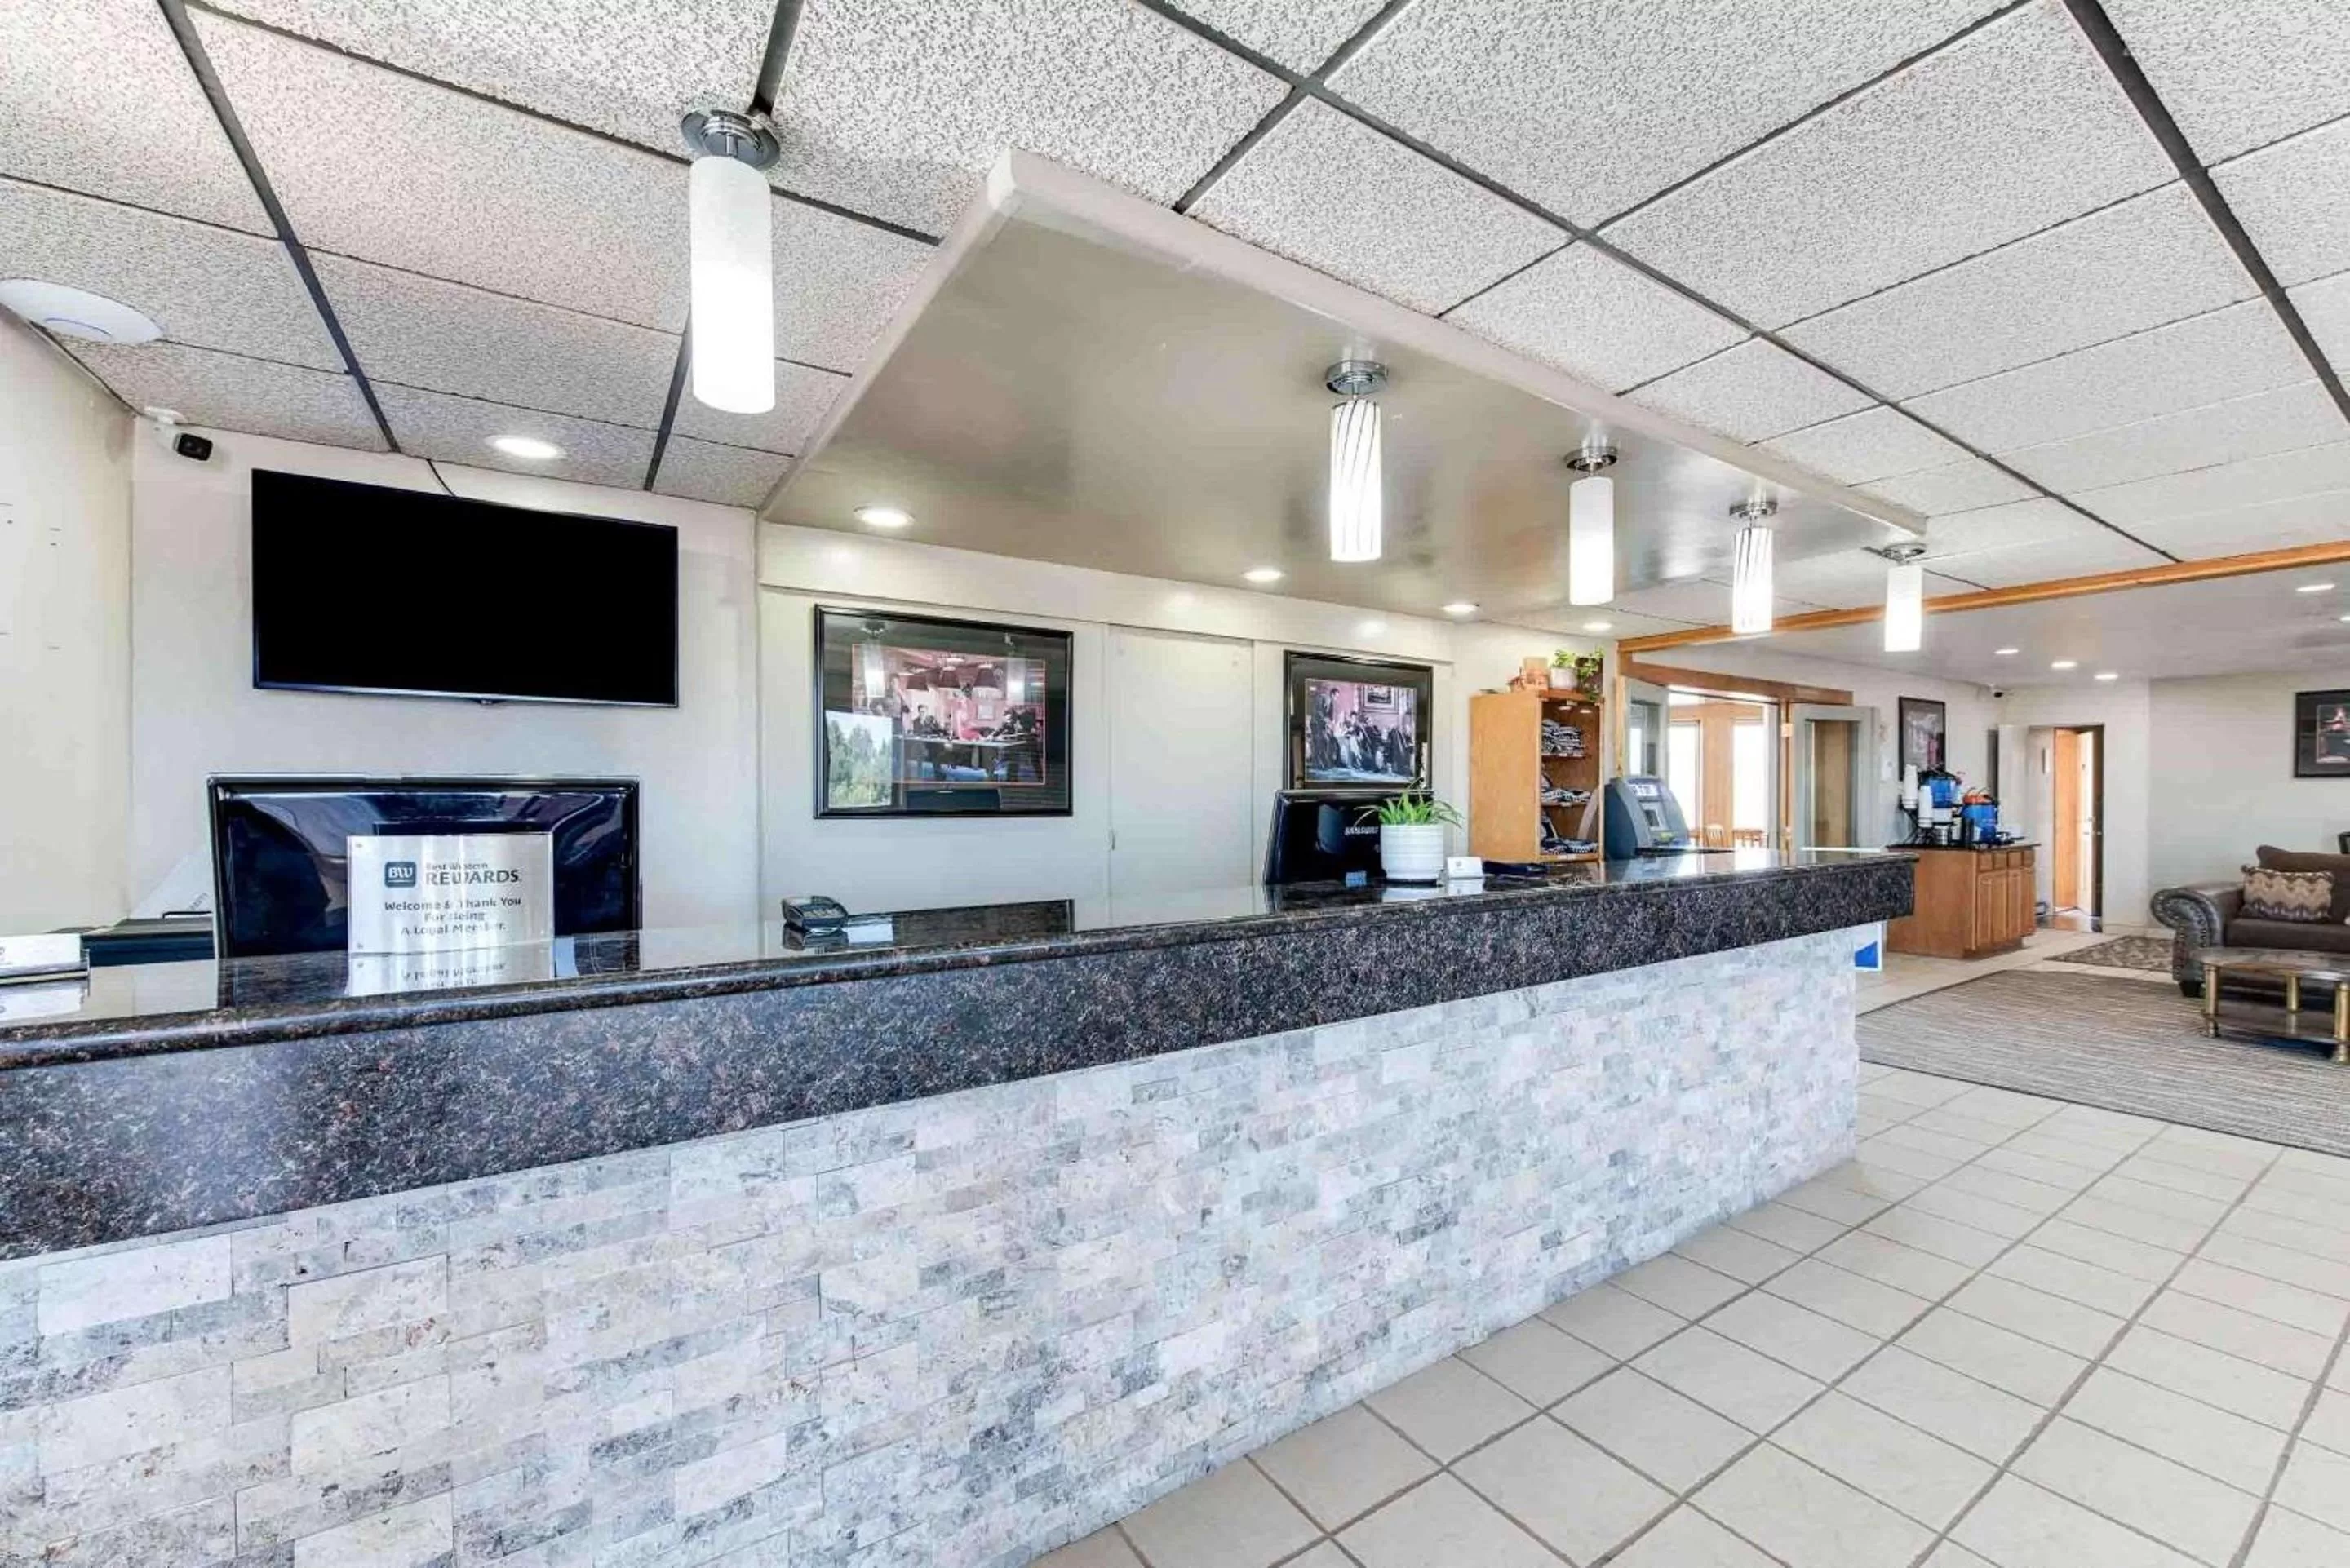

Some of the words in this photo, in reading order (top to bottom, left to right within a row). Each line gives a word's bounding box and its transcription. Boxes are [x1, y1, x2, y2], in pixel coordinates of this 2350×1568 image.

[388, 866, 414, 879] BW
[425, 869, 520, 886] REWARDS
[500, 897, 521, 907] You
